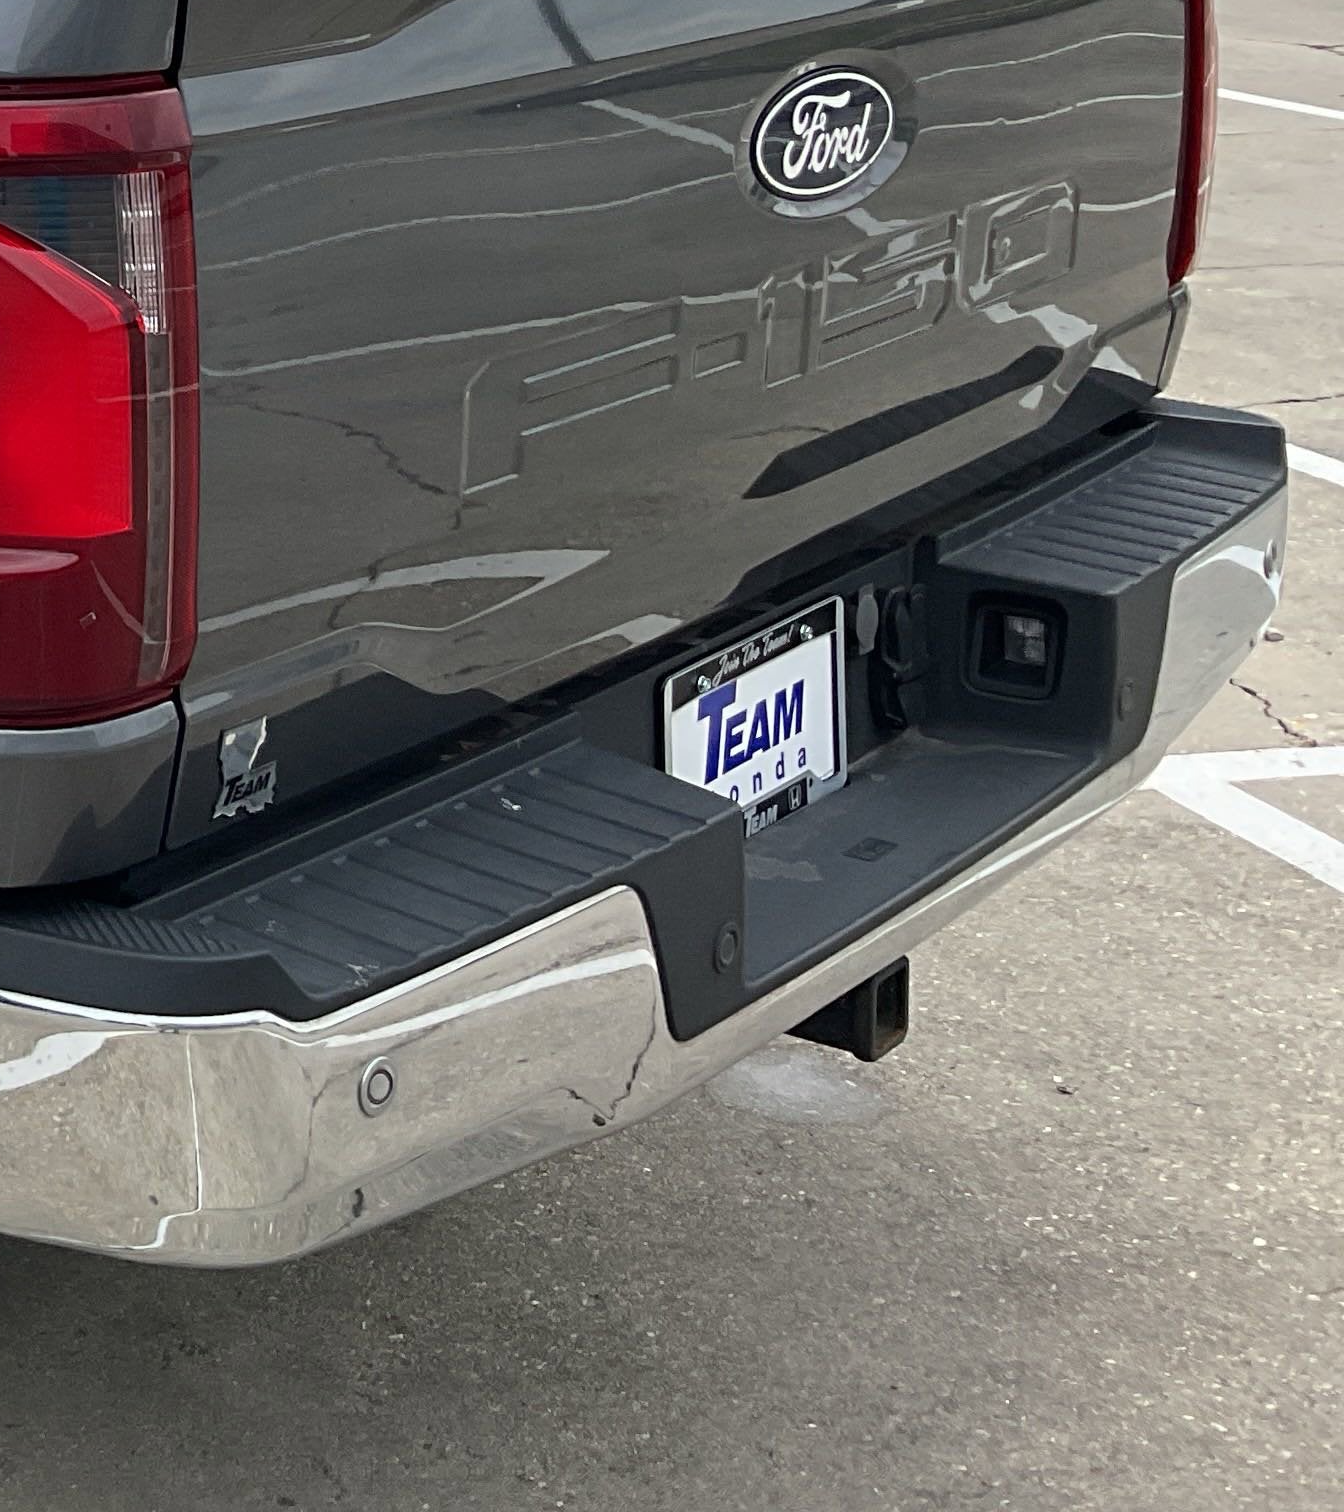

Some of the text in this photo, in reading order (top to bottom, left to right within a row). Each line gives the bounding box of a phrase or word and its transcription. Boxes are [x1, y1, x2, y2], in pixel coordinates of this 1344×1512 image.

[782, 90, 873, 180] Ford
[459, 181, 1079, 495] F-150
[696, 678, 805, 786] TEAM
[223, 771, 271, 806] TEAM
[744, 803, 778, 838] TEAM
